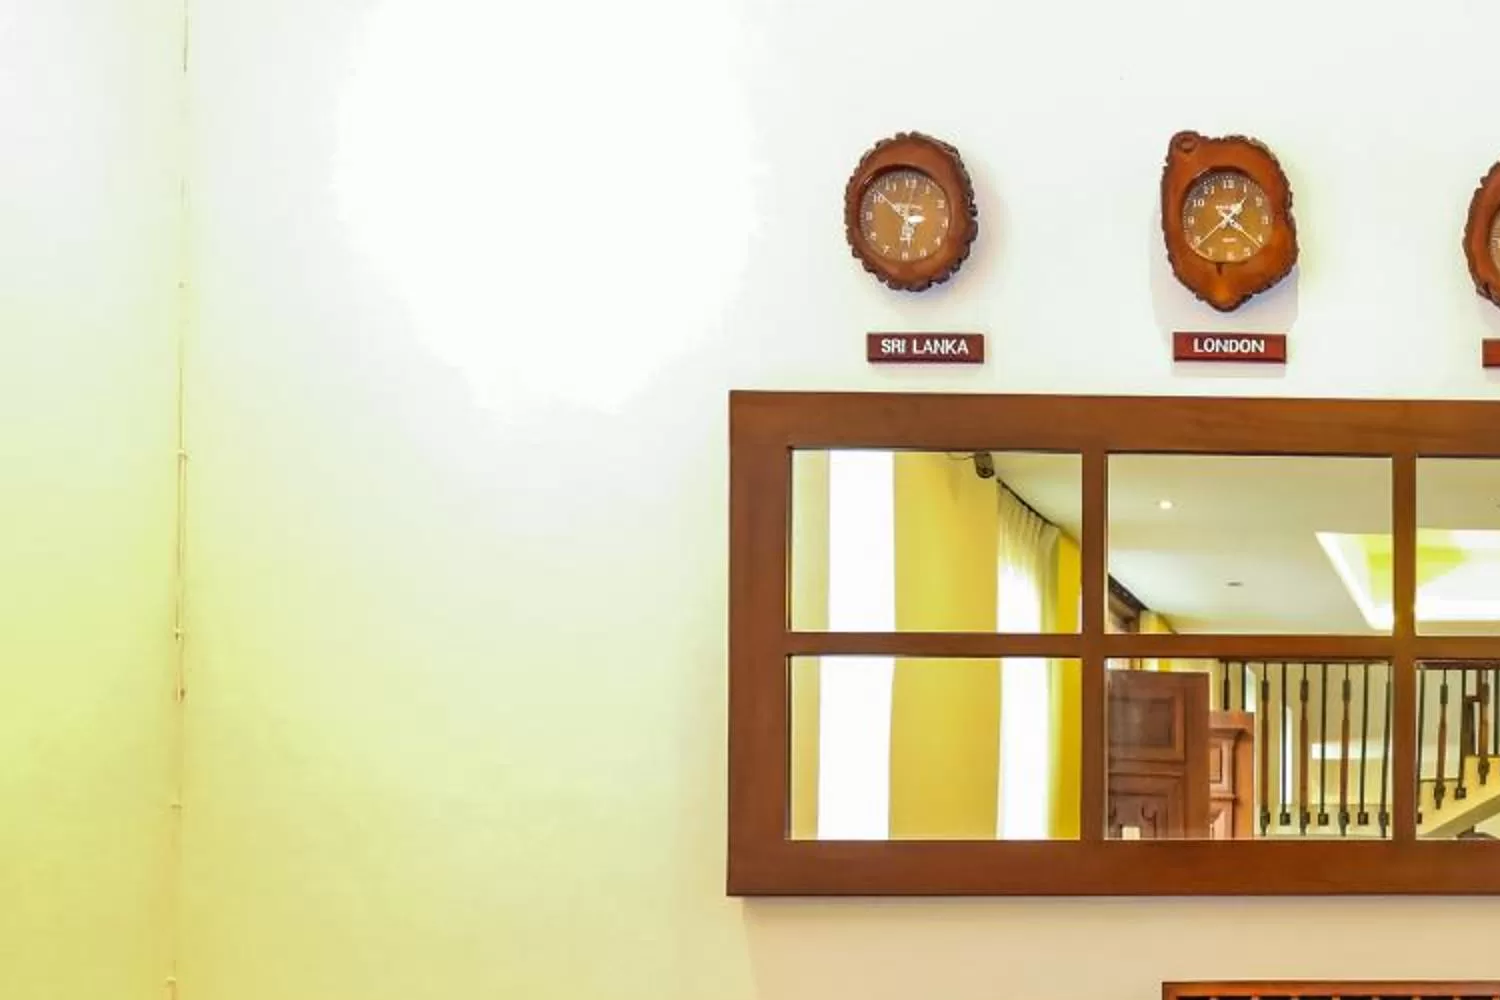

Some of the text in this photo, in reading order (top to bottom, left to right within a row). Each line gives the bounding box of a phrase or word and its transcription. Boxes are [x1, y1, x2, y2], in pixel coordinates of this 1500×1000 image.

[881, 337, 969, 355] SRI LANKA
[1193, 337, 1265, 354] LONDON
